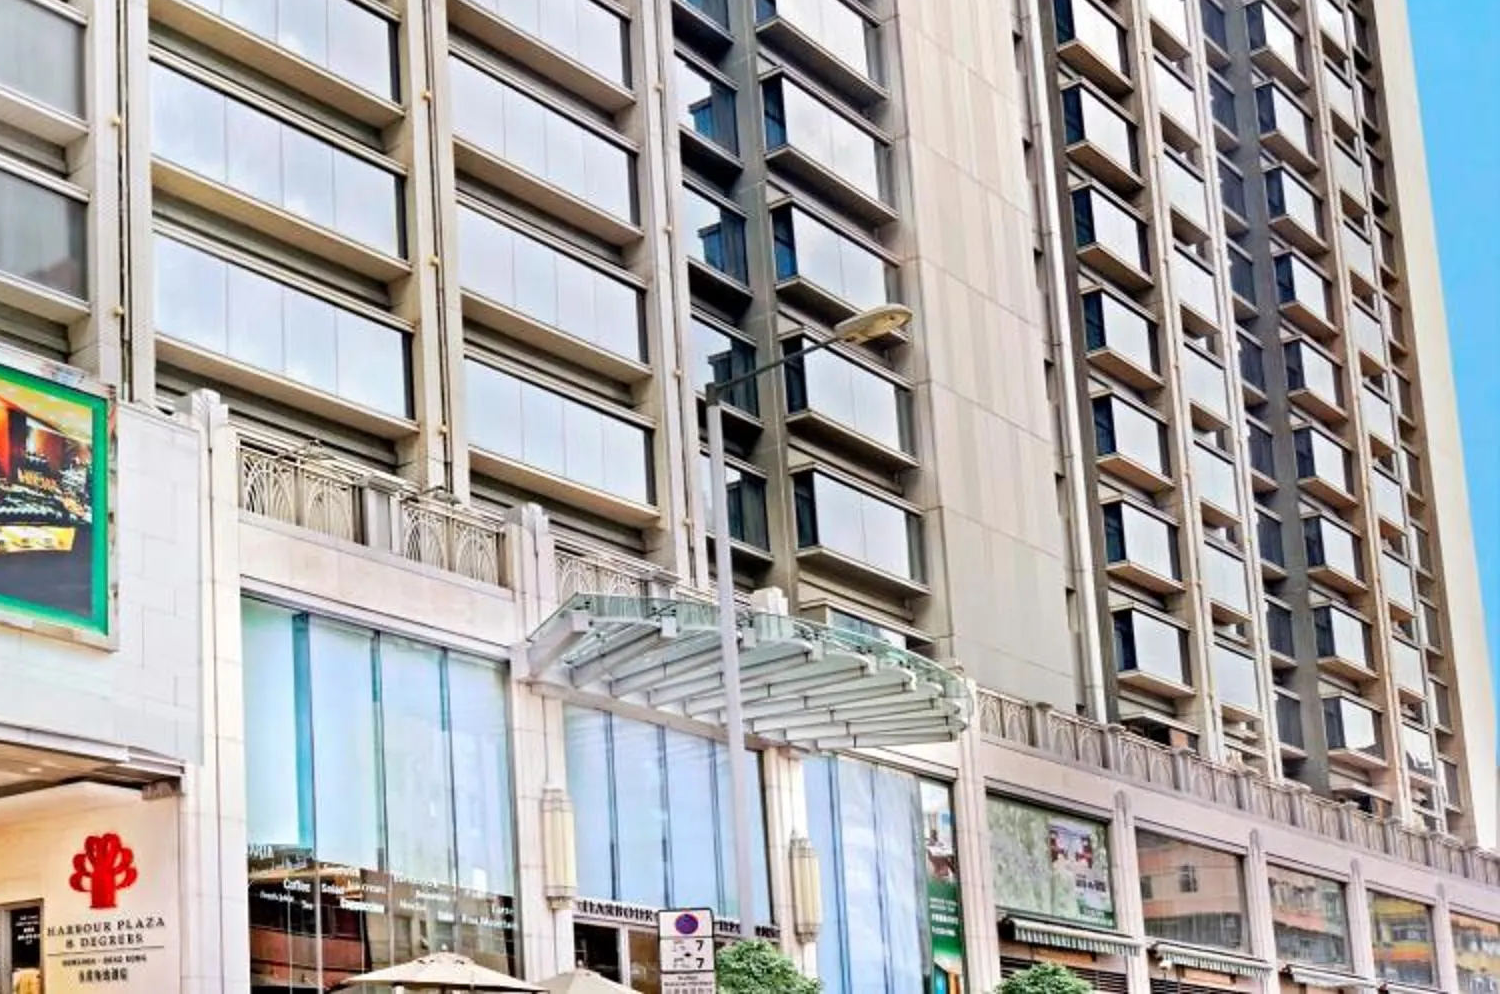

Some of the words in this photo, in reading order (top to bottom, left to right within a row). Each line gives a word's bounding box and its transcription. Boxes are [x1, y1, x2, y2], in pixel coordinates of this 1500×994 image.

[46, 921, 112, 937] HARBOUR
[117, 917, 165, 931] PLAZA
[80, 933, 144, 948] DEGREES
[695, 939, 704, 952] 7
[696, 957, 705, 969] 7
